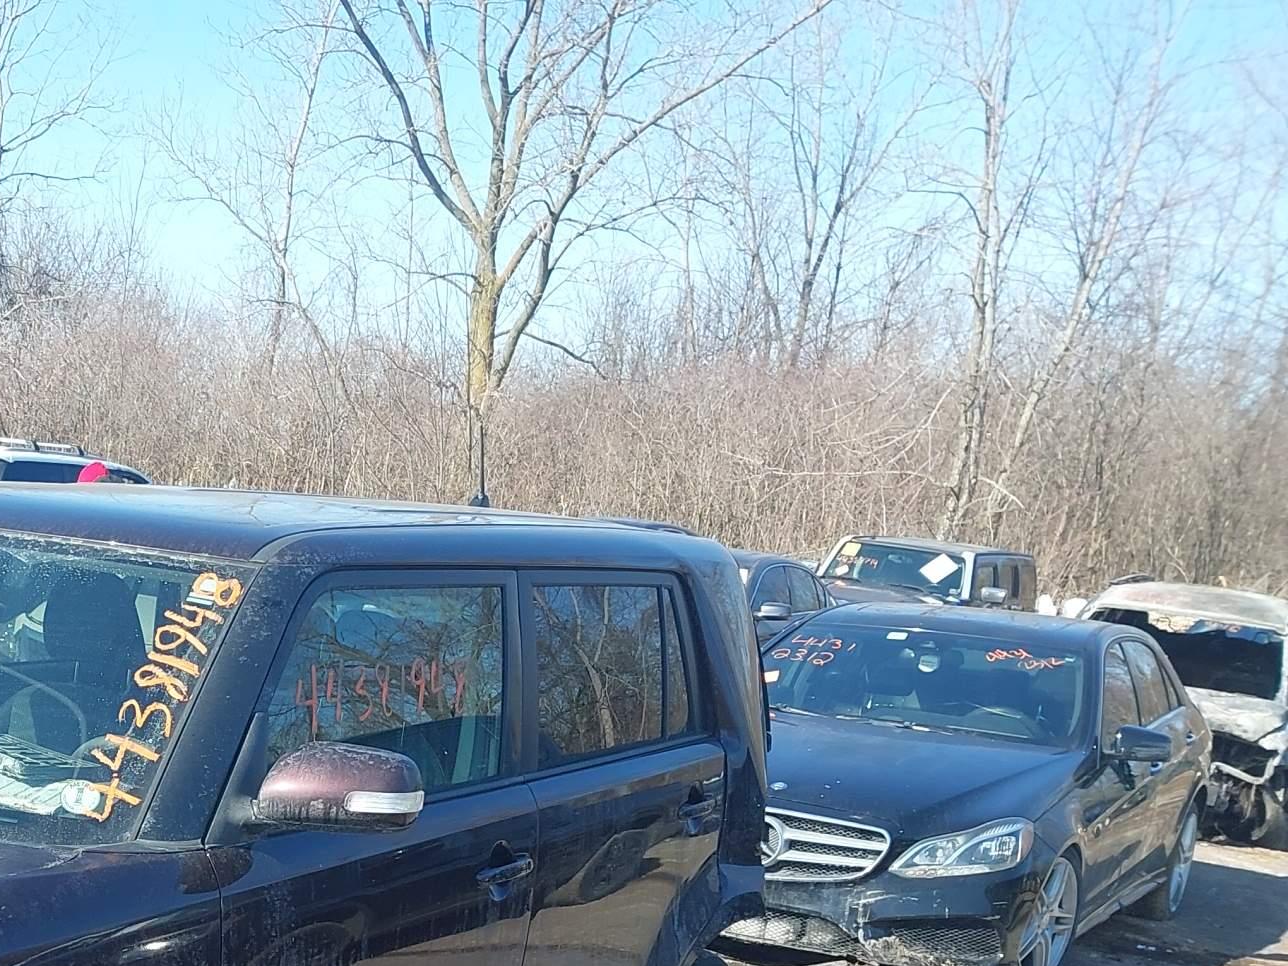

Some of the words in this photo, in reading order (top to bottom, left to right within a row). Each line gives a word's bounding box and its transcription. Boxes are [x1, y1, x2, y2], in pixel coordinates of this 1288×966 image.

[791, 634, 856, 651] 4431
[771, 648, 834, 667] 2312
[82, 572, 245, 823] 44381948
